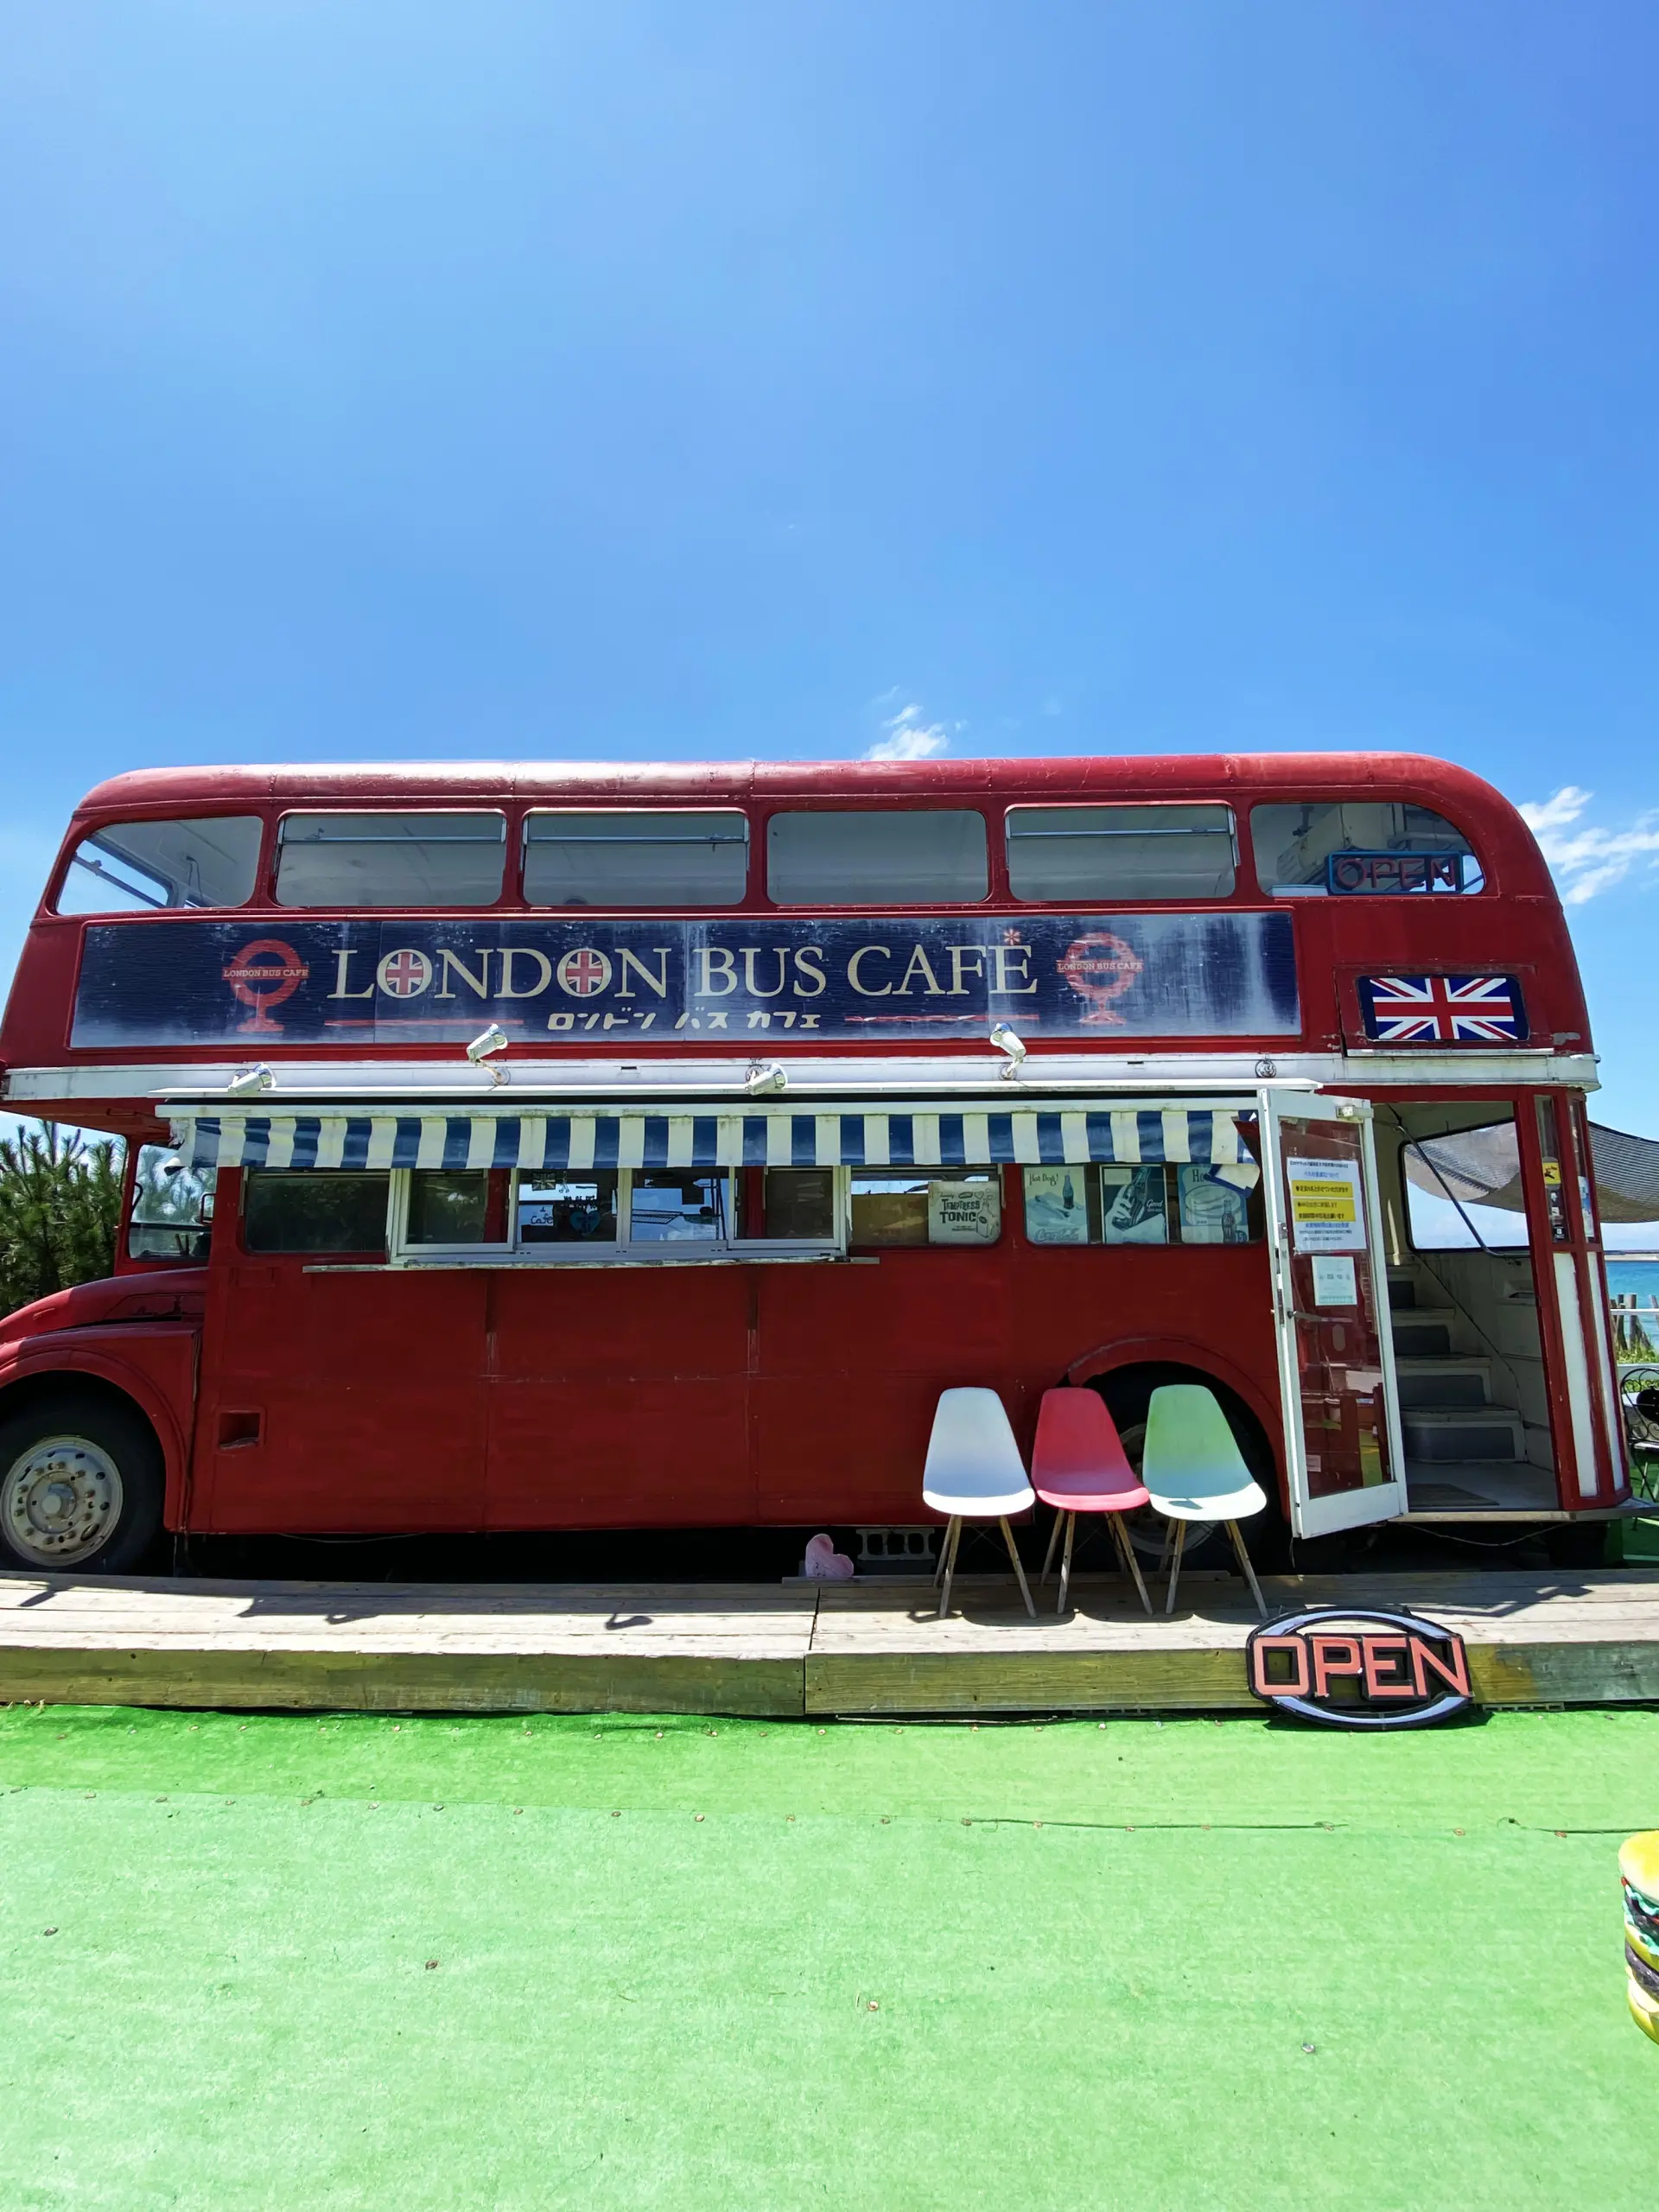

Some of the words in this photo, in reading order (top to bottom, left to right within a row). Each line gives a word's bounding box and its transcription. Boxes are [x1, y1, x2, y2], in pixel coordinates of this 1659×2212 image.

[1337, 859, 1456, 888] OPEN
[327, 948, 672, 999] LONDON
[693, 946, 827, 997] BUS
[547, 1007, 657, 1030] ロンドン
[674, 1007, 728, 1029] バス
[746, 1010, 822, 1028] カフェ
[1029, 1173, 1040, 1185] Hot
[1146, 1199, 1164, 1210] Good
[939, 1211, 976, 1224] TONIC
[1253, 1636, 1471, 1698] OPEN
